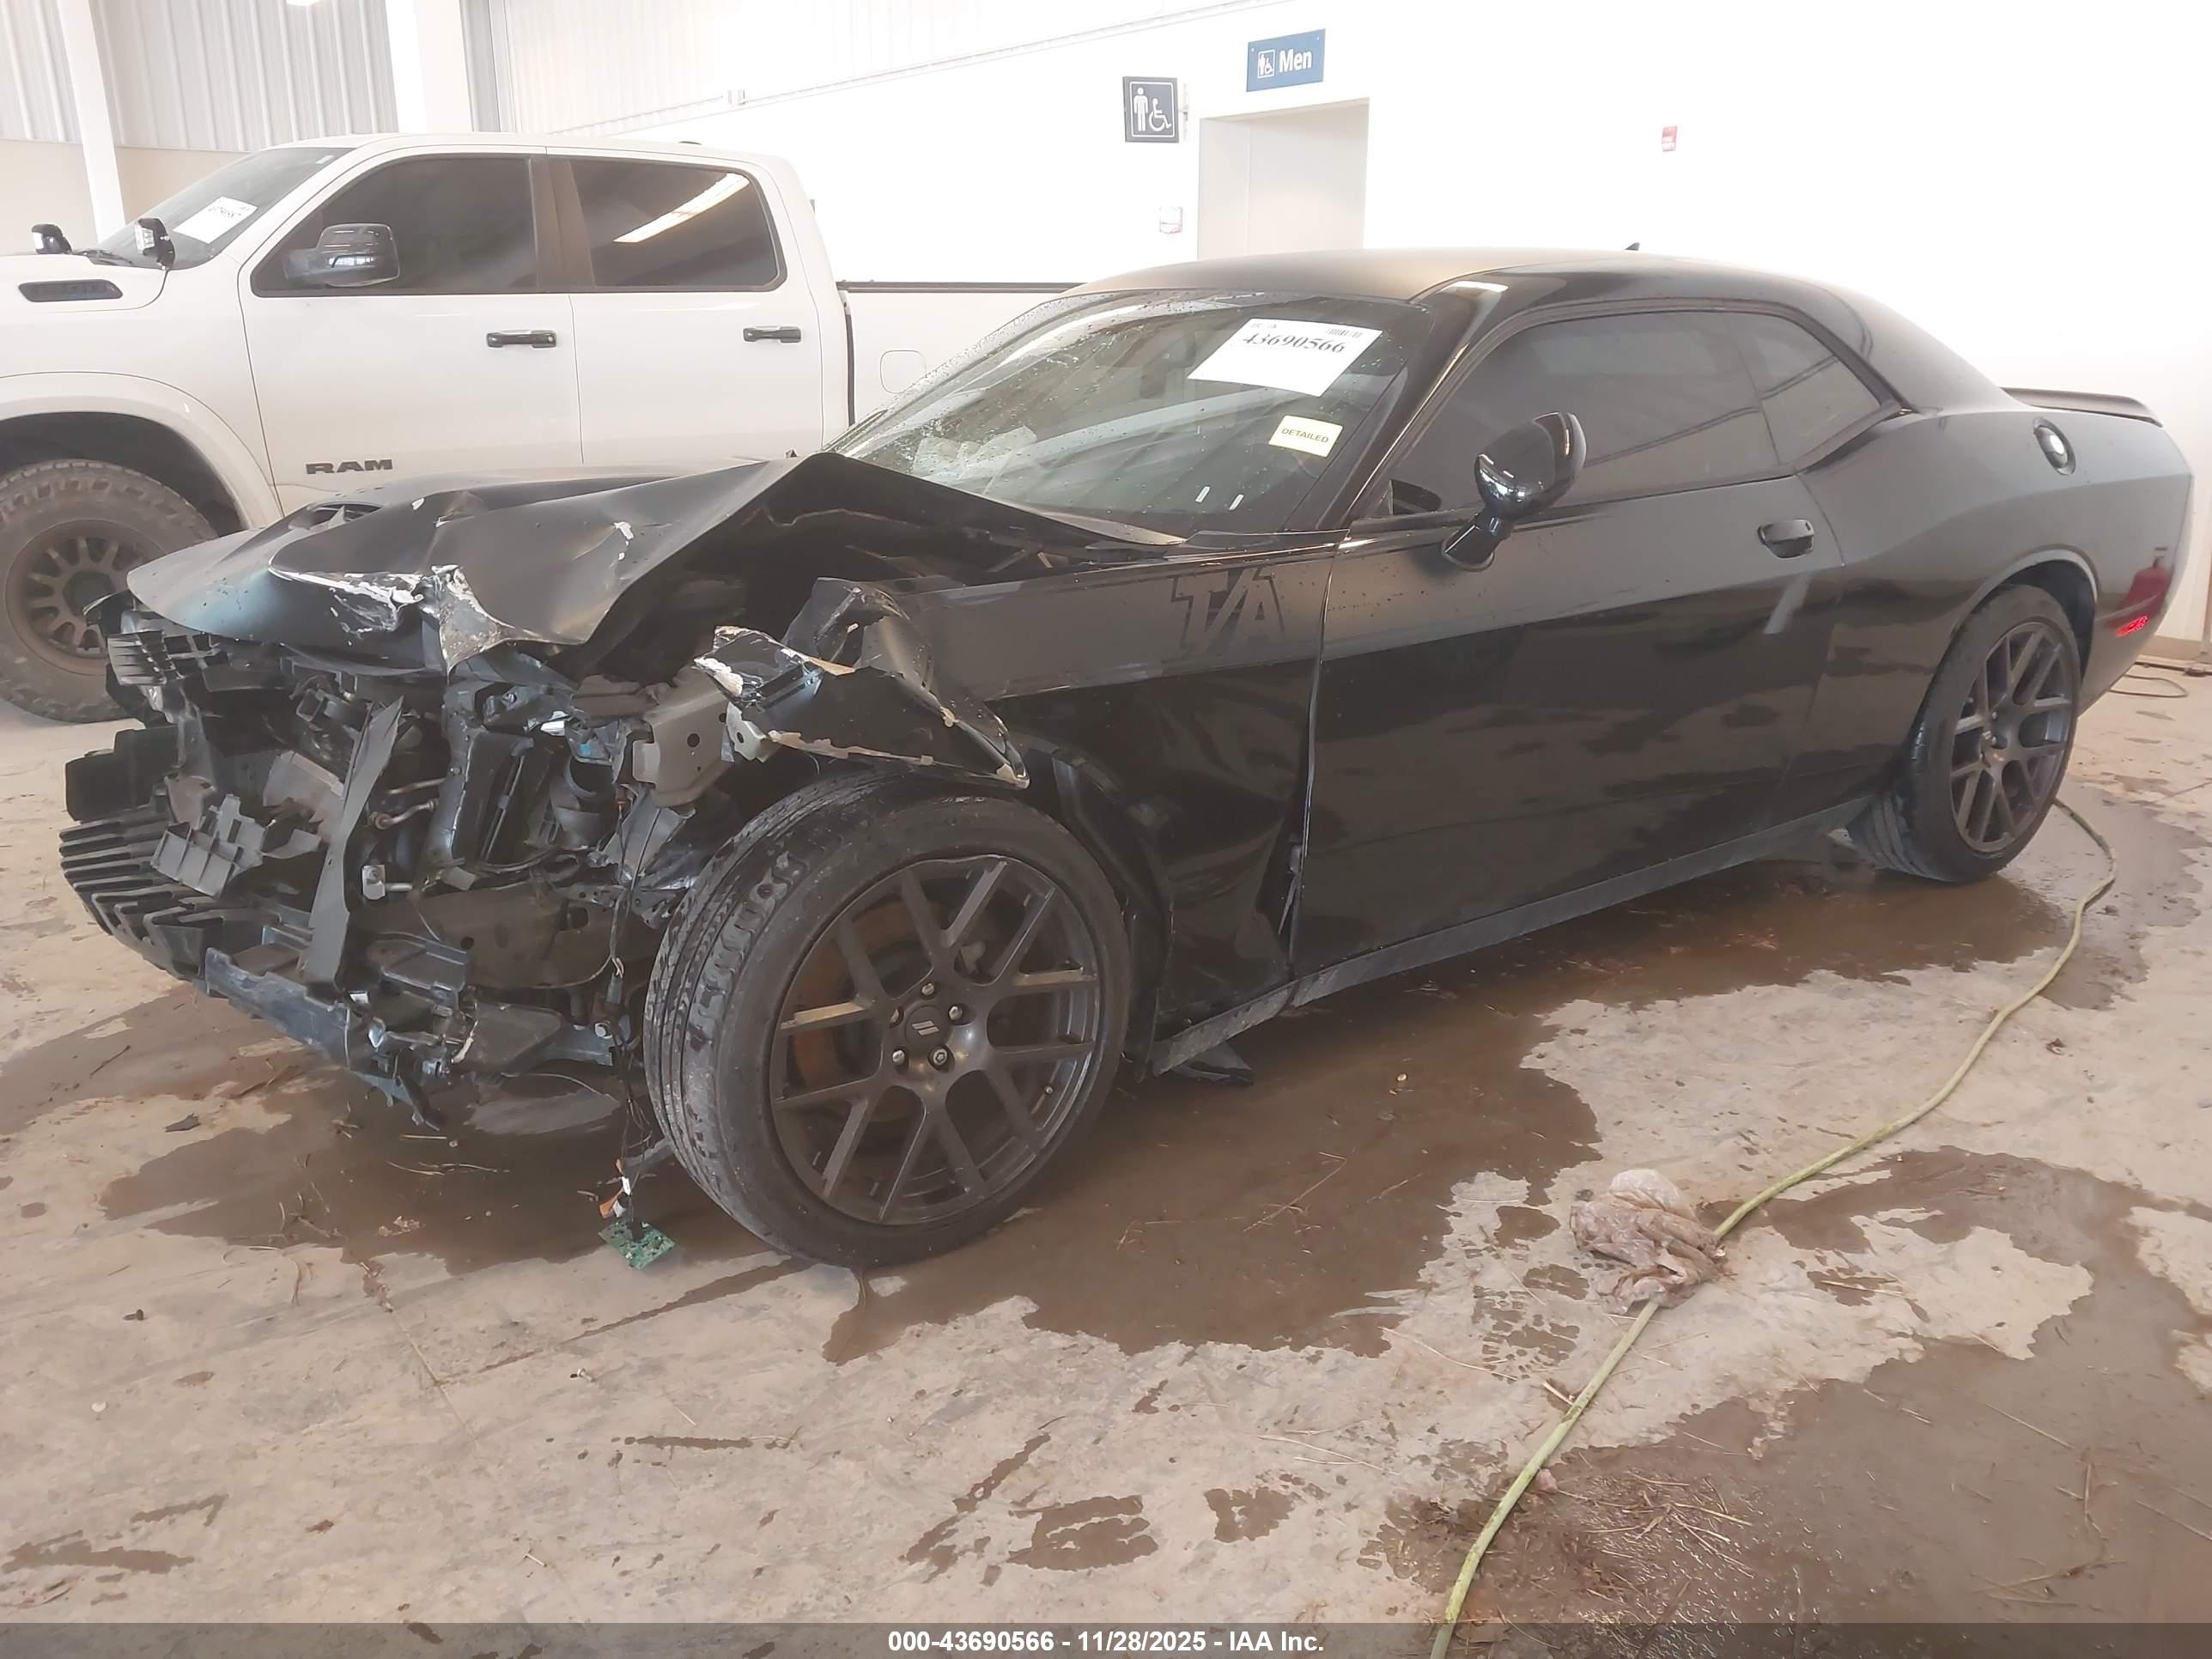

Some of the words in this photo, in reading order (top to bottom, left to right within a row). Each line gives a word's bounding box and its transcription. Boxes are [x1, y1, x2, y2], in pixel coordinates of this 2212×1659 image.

[1279, 48, 1312, 72] Men
[1243, 332, 1346, 353] 43690566
[1280, 427, 1329, 443] DETAILED
[305, 459, 393, 475] RAM
